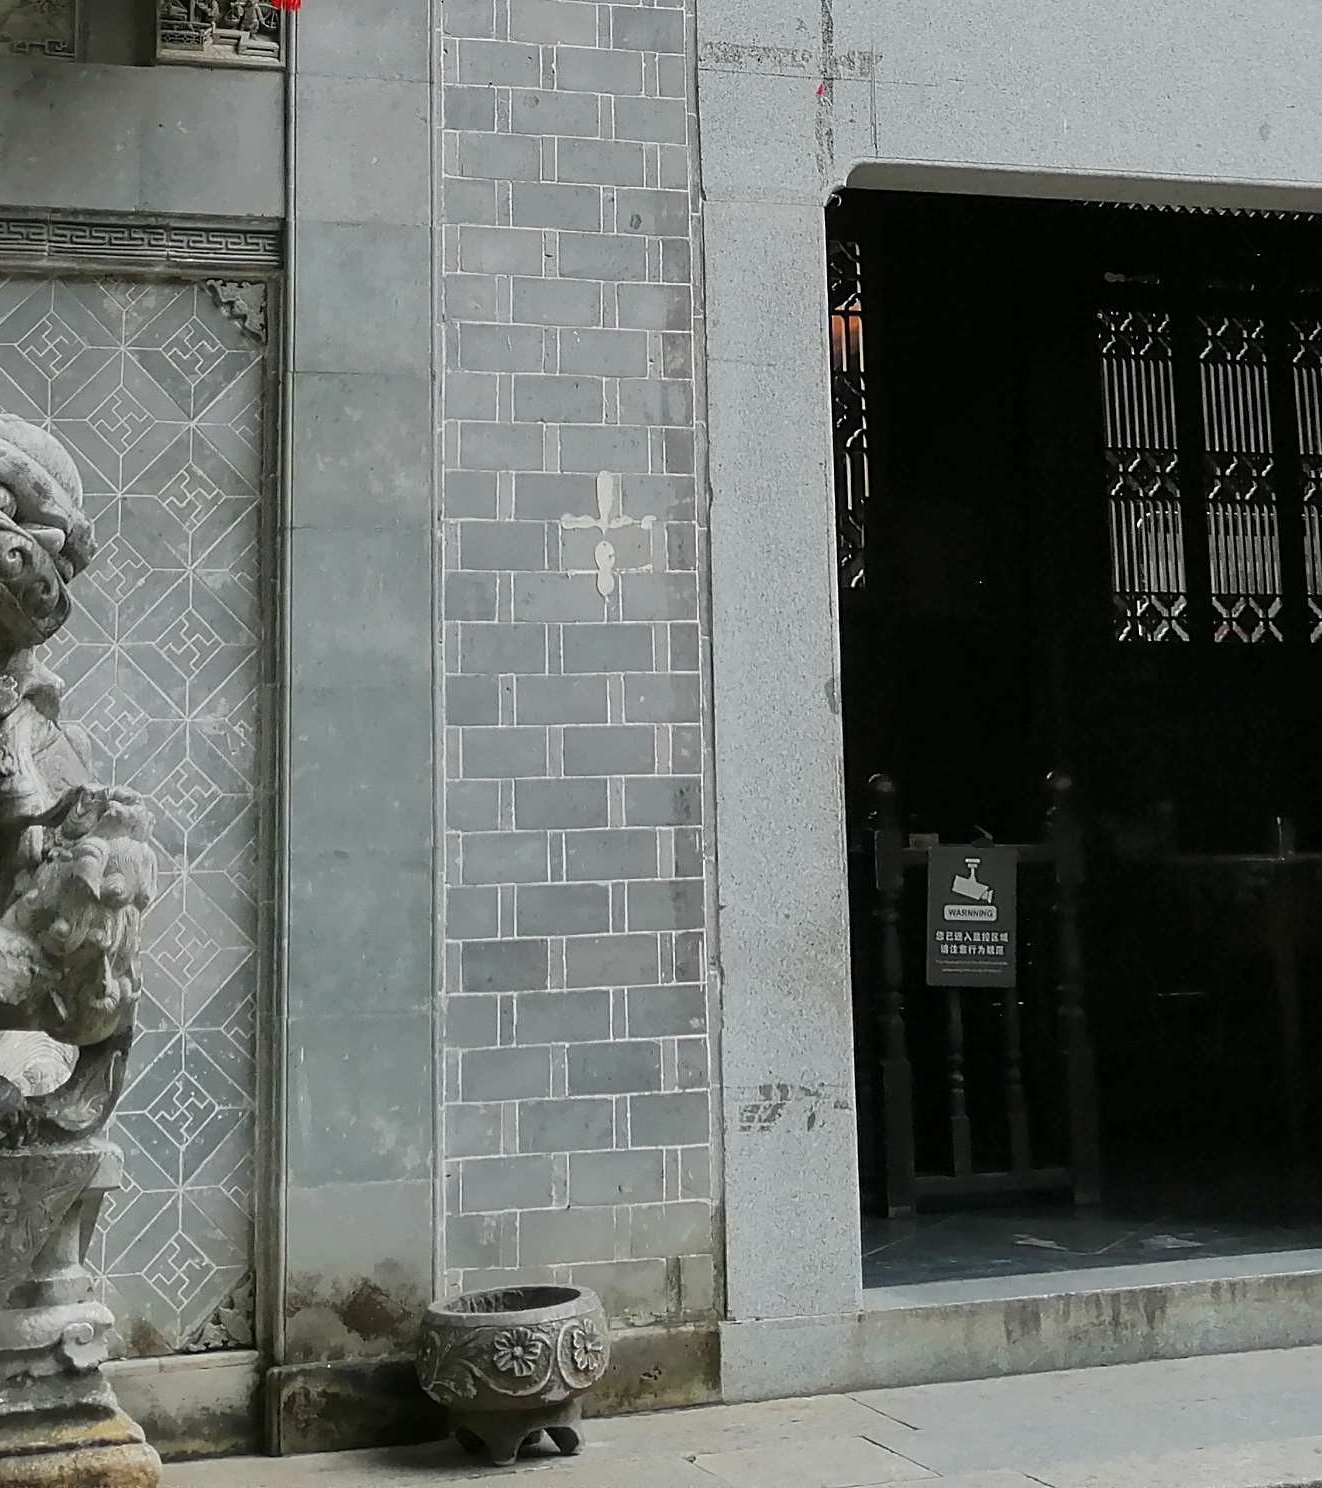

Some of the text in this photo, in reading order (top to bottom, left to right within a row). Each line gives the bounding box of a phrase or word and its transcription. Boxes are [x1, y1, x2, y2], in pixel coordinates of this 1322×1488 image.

[935, 930, 1009, 943] 您已进入监控区域
[940, 944, 1005, 956] 请注意行为规范
